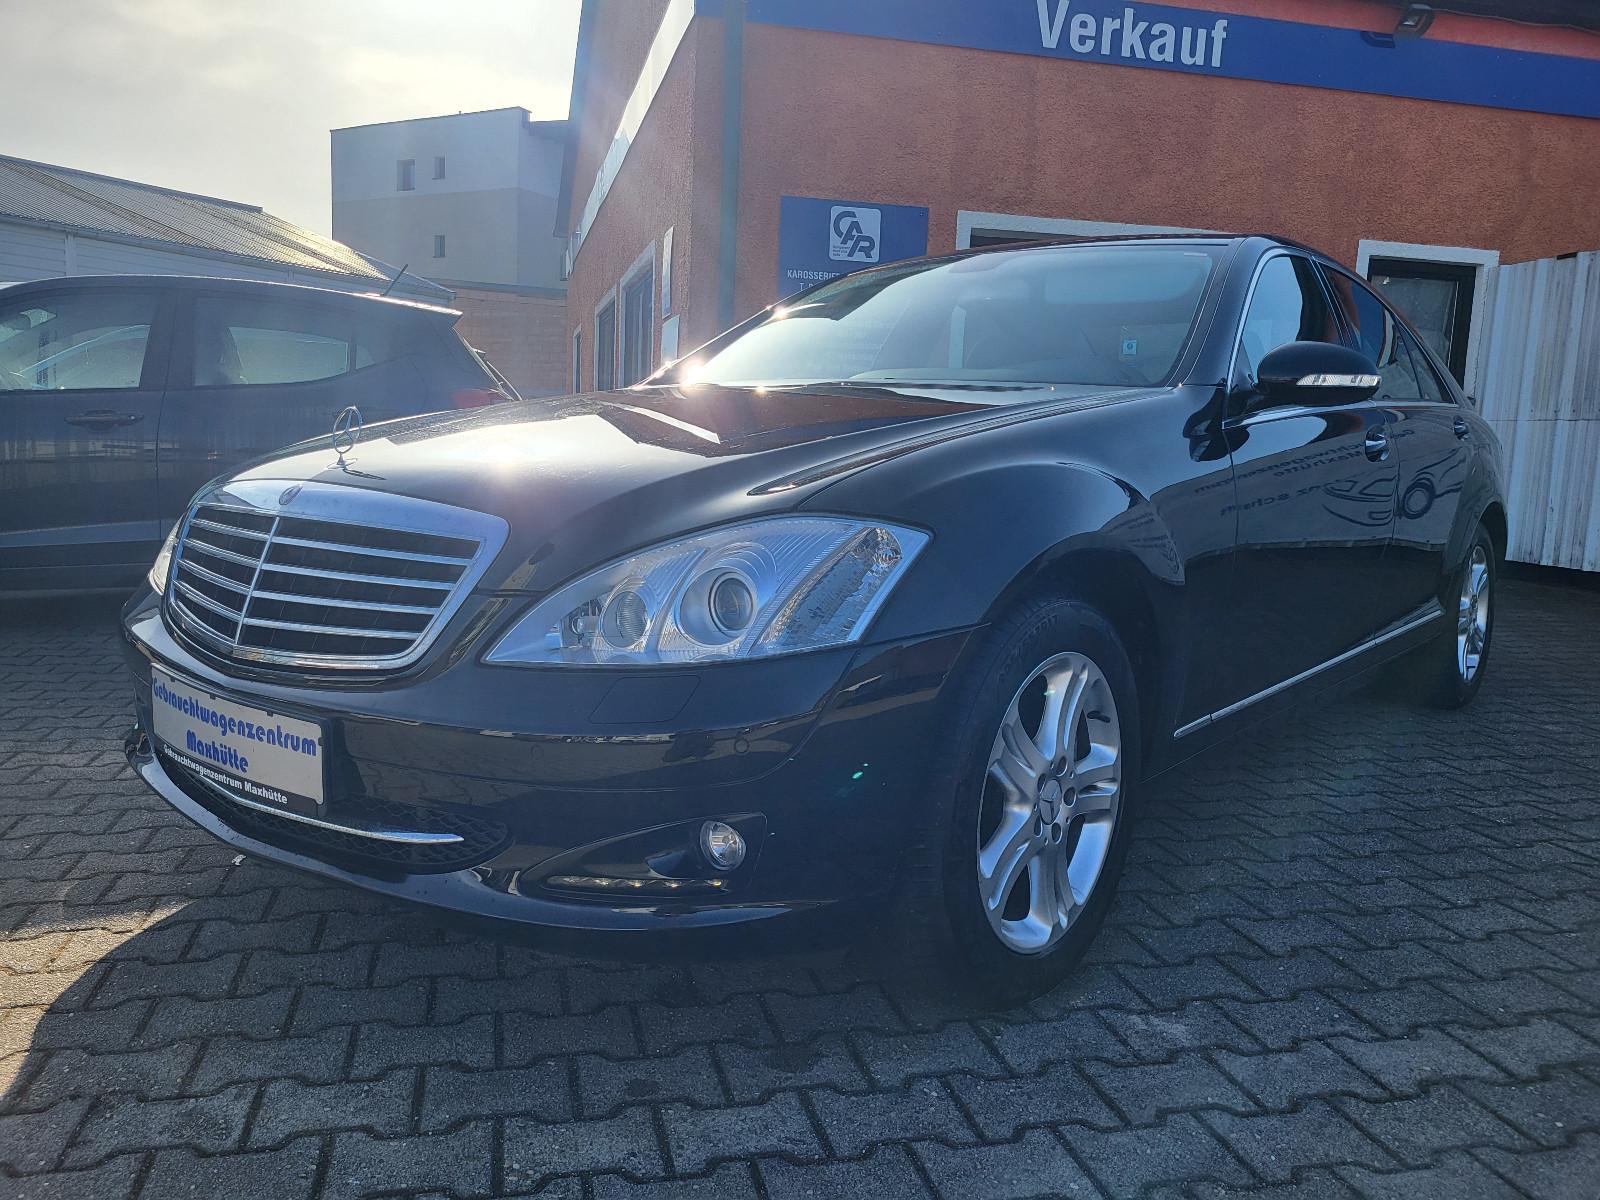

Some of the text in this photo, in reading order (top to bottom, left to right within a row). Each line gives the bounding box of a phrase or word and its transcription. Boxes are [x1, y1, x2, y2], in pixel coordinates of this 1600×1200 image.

[1037, 0, 1228, 67] Verkauf
[833, 210, 876, 258] CAR
[153, 677, 317, 757] Gebrauchtwagenzentrum
[163, 743, 288, 804] Gebrauchtwagenzentrum Maxhütte
[186, 729, 249, 773] Maxhütte
